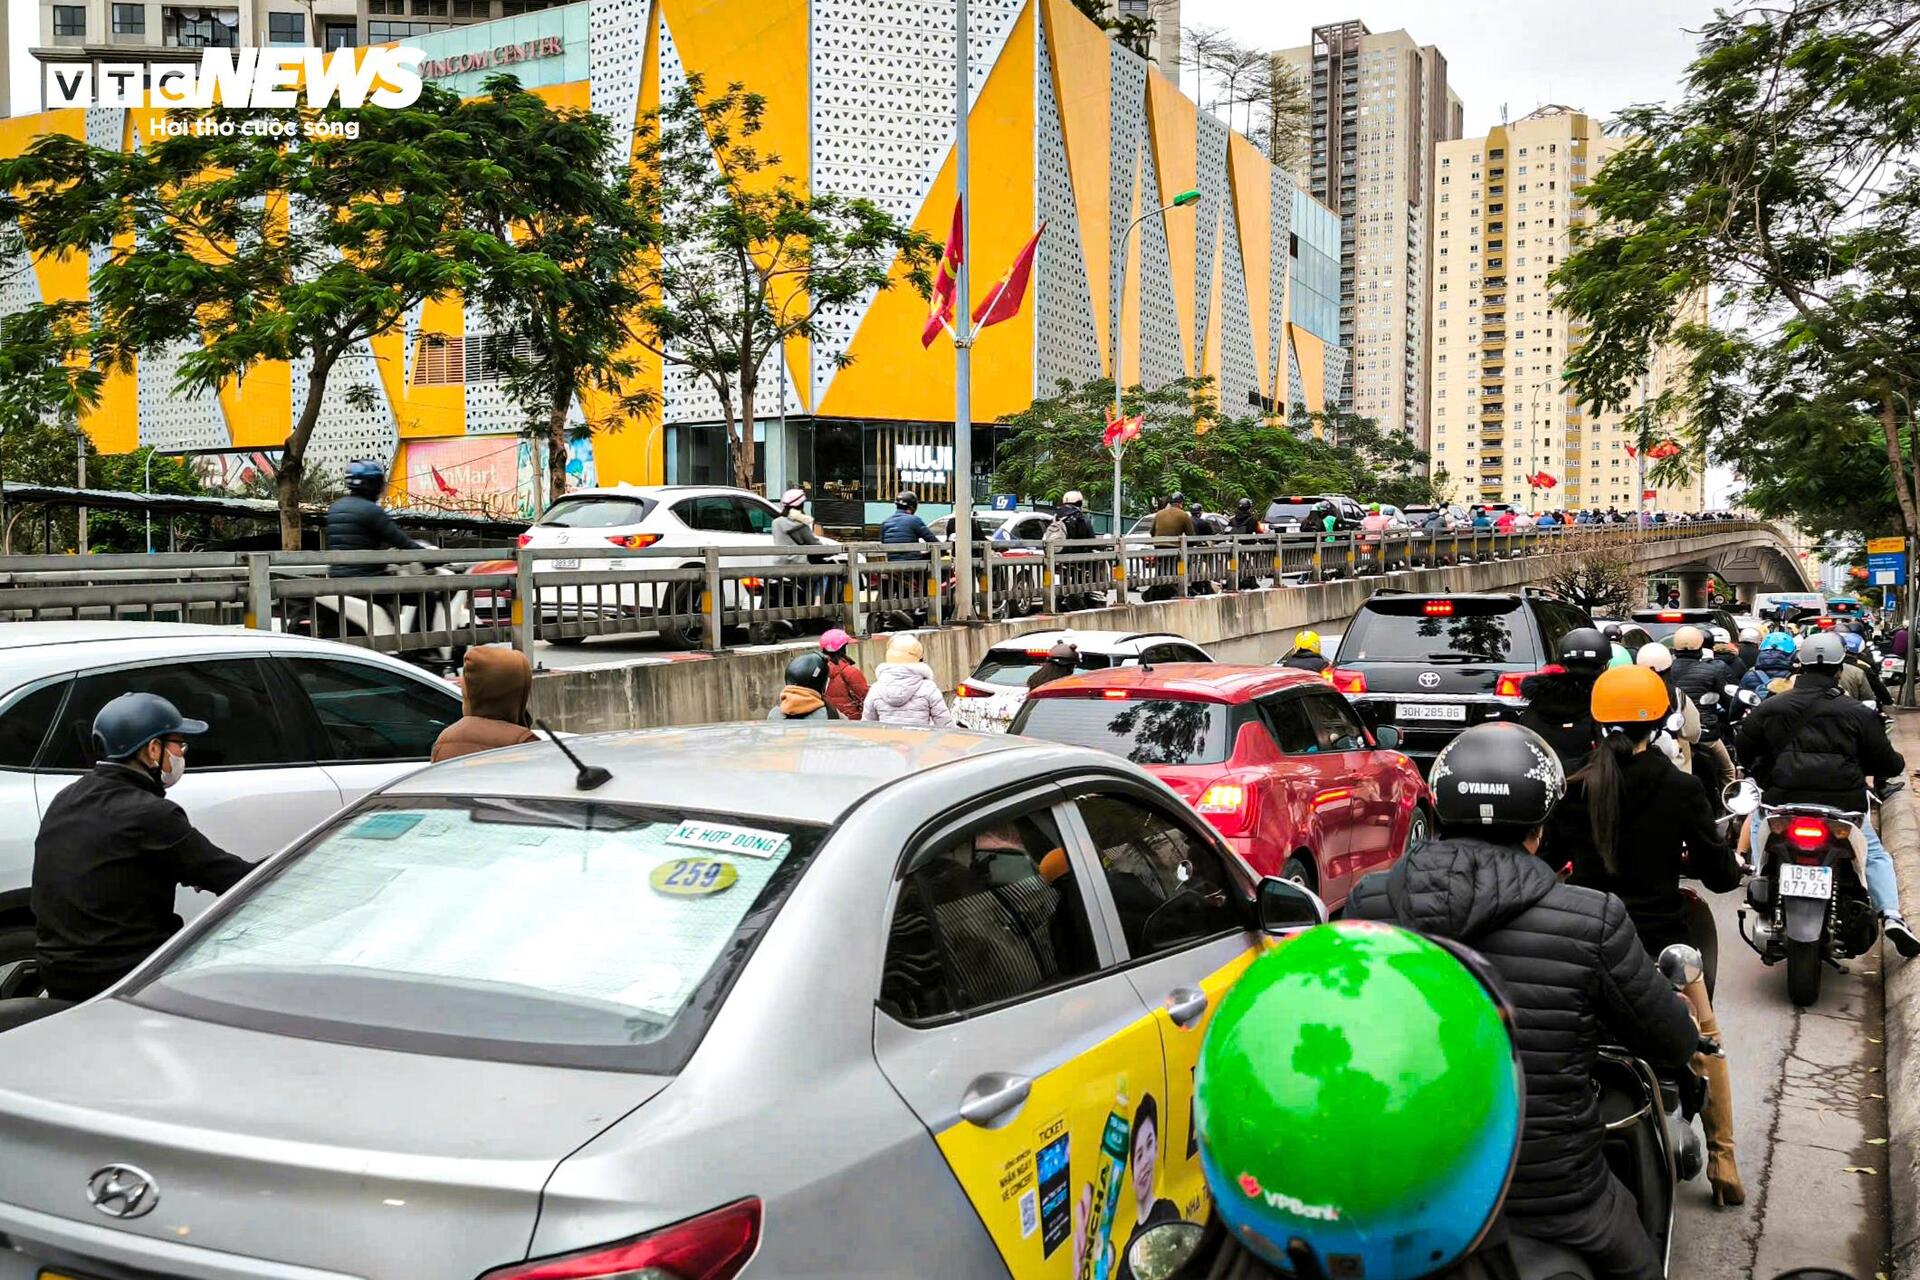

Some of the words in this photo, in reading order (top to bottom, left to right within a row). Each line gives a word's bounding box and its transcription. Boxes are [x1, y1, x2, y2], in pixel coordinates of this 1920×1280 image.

[417, 48, 488, 80] VINCOM
[491, 36, 565, 67] CENTER
[895, 444, 953, 470] MUJI
[996, 496, 1009, 510] G7
[1468, 782, 1510, 796] YAMAHA
[676, 826, 699, 840] XE
[664, 861, 722, 888] 259
[1783, 880, 1828, 897] 977.25
[1038, 1118, 1065, 1144] TICKET
